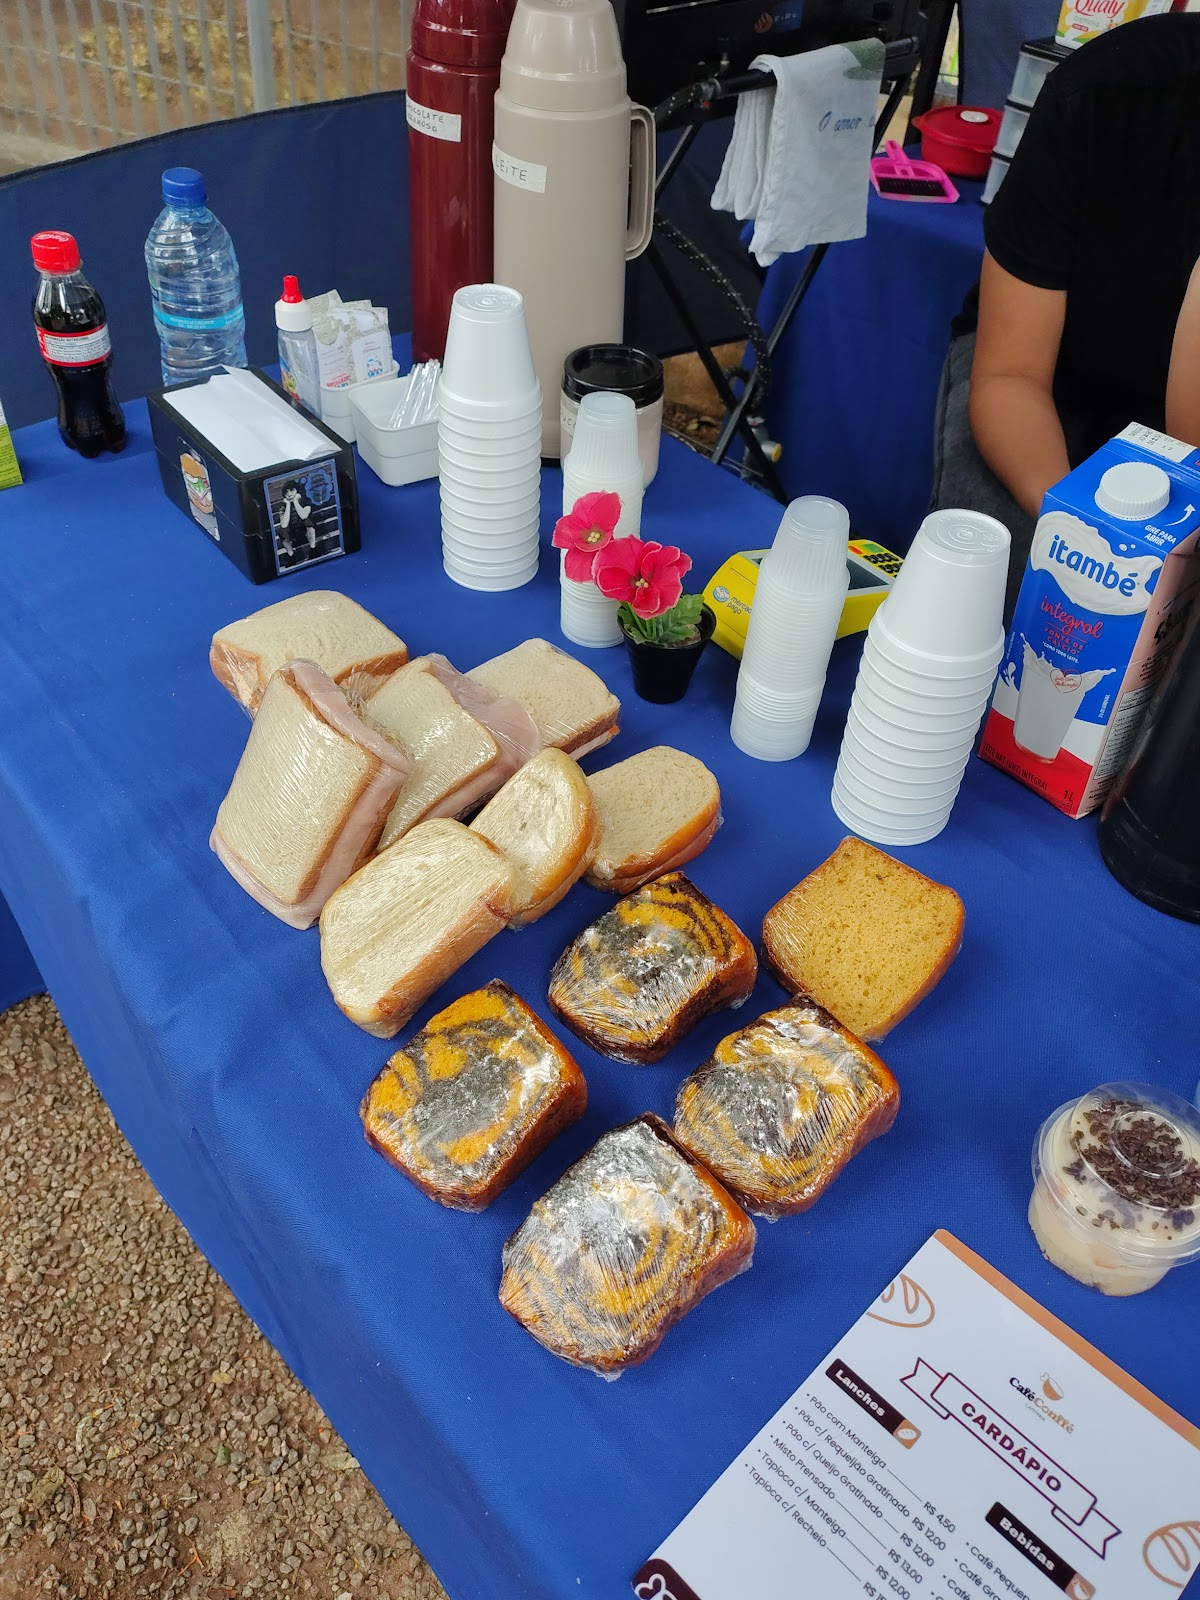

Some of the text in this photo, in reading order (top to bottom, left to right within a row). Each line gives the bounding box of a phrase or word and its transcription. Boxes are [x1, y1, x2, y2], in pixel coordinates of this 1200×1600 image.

[1144, 534, 1166, 546] ABRIR
[1145, 525, 1177, 544] GIRE PARA
[1049, 535, 1138, 597] itambé
[726, 602, 742, 615] pago
[1040, 595, 1104, 638] integral
[1045, 627, 1084, 650] FONTE DE
[1021, 766, 1049, 791] INTEGRAL
[835, 1369, 886, 1417] Lanches
[809, 1396, 956, 1533] Pão com Manteiga R$ 4,50
[961, 1402, 1062, 1492] CARDÁPIO
[785, 1423, 934, 1567] Pão c/ Queijo Gratinado R$ 12,00
[798, 1410, 946, 1551] Pão c/ Requeijão Gratinado R$ 12,00
[748, 1466, 782, 1502] Tapioca
[781, 1501, 796, 1512] c/
[792, 1511, 827, 1547] Recheio
[863, 1582, 876, 1597] R$
[761, 1452, 910, 1600] Tapioca c/ Manteiga R$ 12,00
[773, 1438, 923, 1584] Misto Prensado R$ 13,00
[999, 1517, 1056, 1571] Bebidas
[947, 1578, 970, 1600] Café
[959, 1562, 982, 1586] Café
[970, 1546, 1031, 1600] Café Pequen
